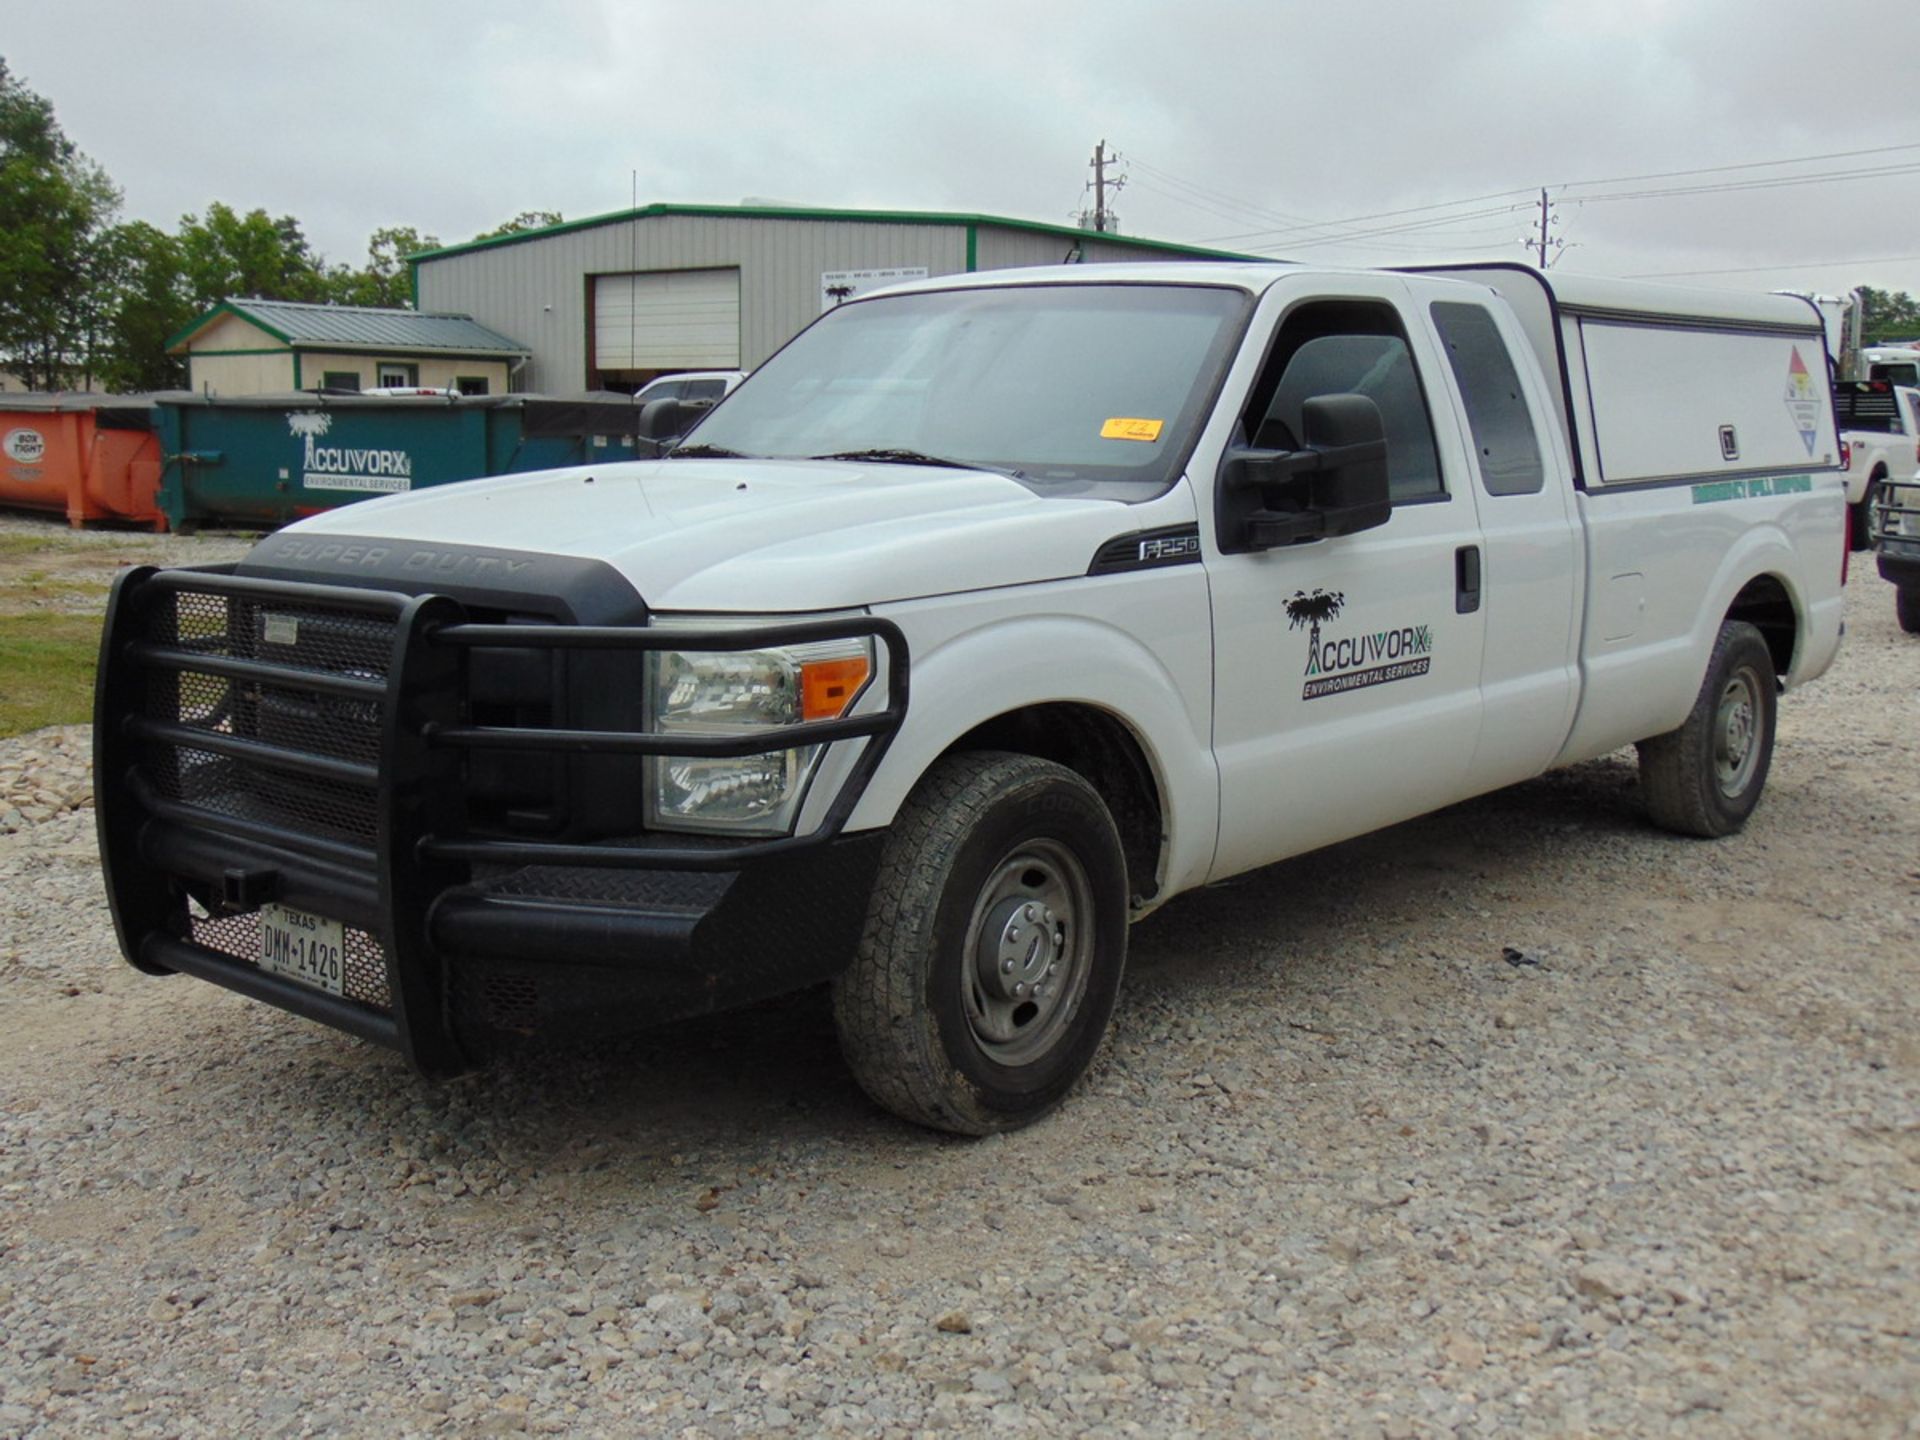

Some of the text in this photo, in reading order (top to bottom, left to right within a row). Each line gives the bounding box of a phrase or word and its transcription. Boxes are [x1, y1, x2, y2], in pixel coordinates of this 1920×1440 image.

[14, 444, 43, 454] TIGHT
[305, 475, 409, 491] ENVIRONMENTAL SERVICES
[276, 542, 532, 574] SUPER DUTY
[1304, 625, 1428, 676] ACCUWORX
[1304, 659, 1429, 697] ENVIRONMENTAL SERVICES
[283, 909, 316, 931] TEXAS
